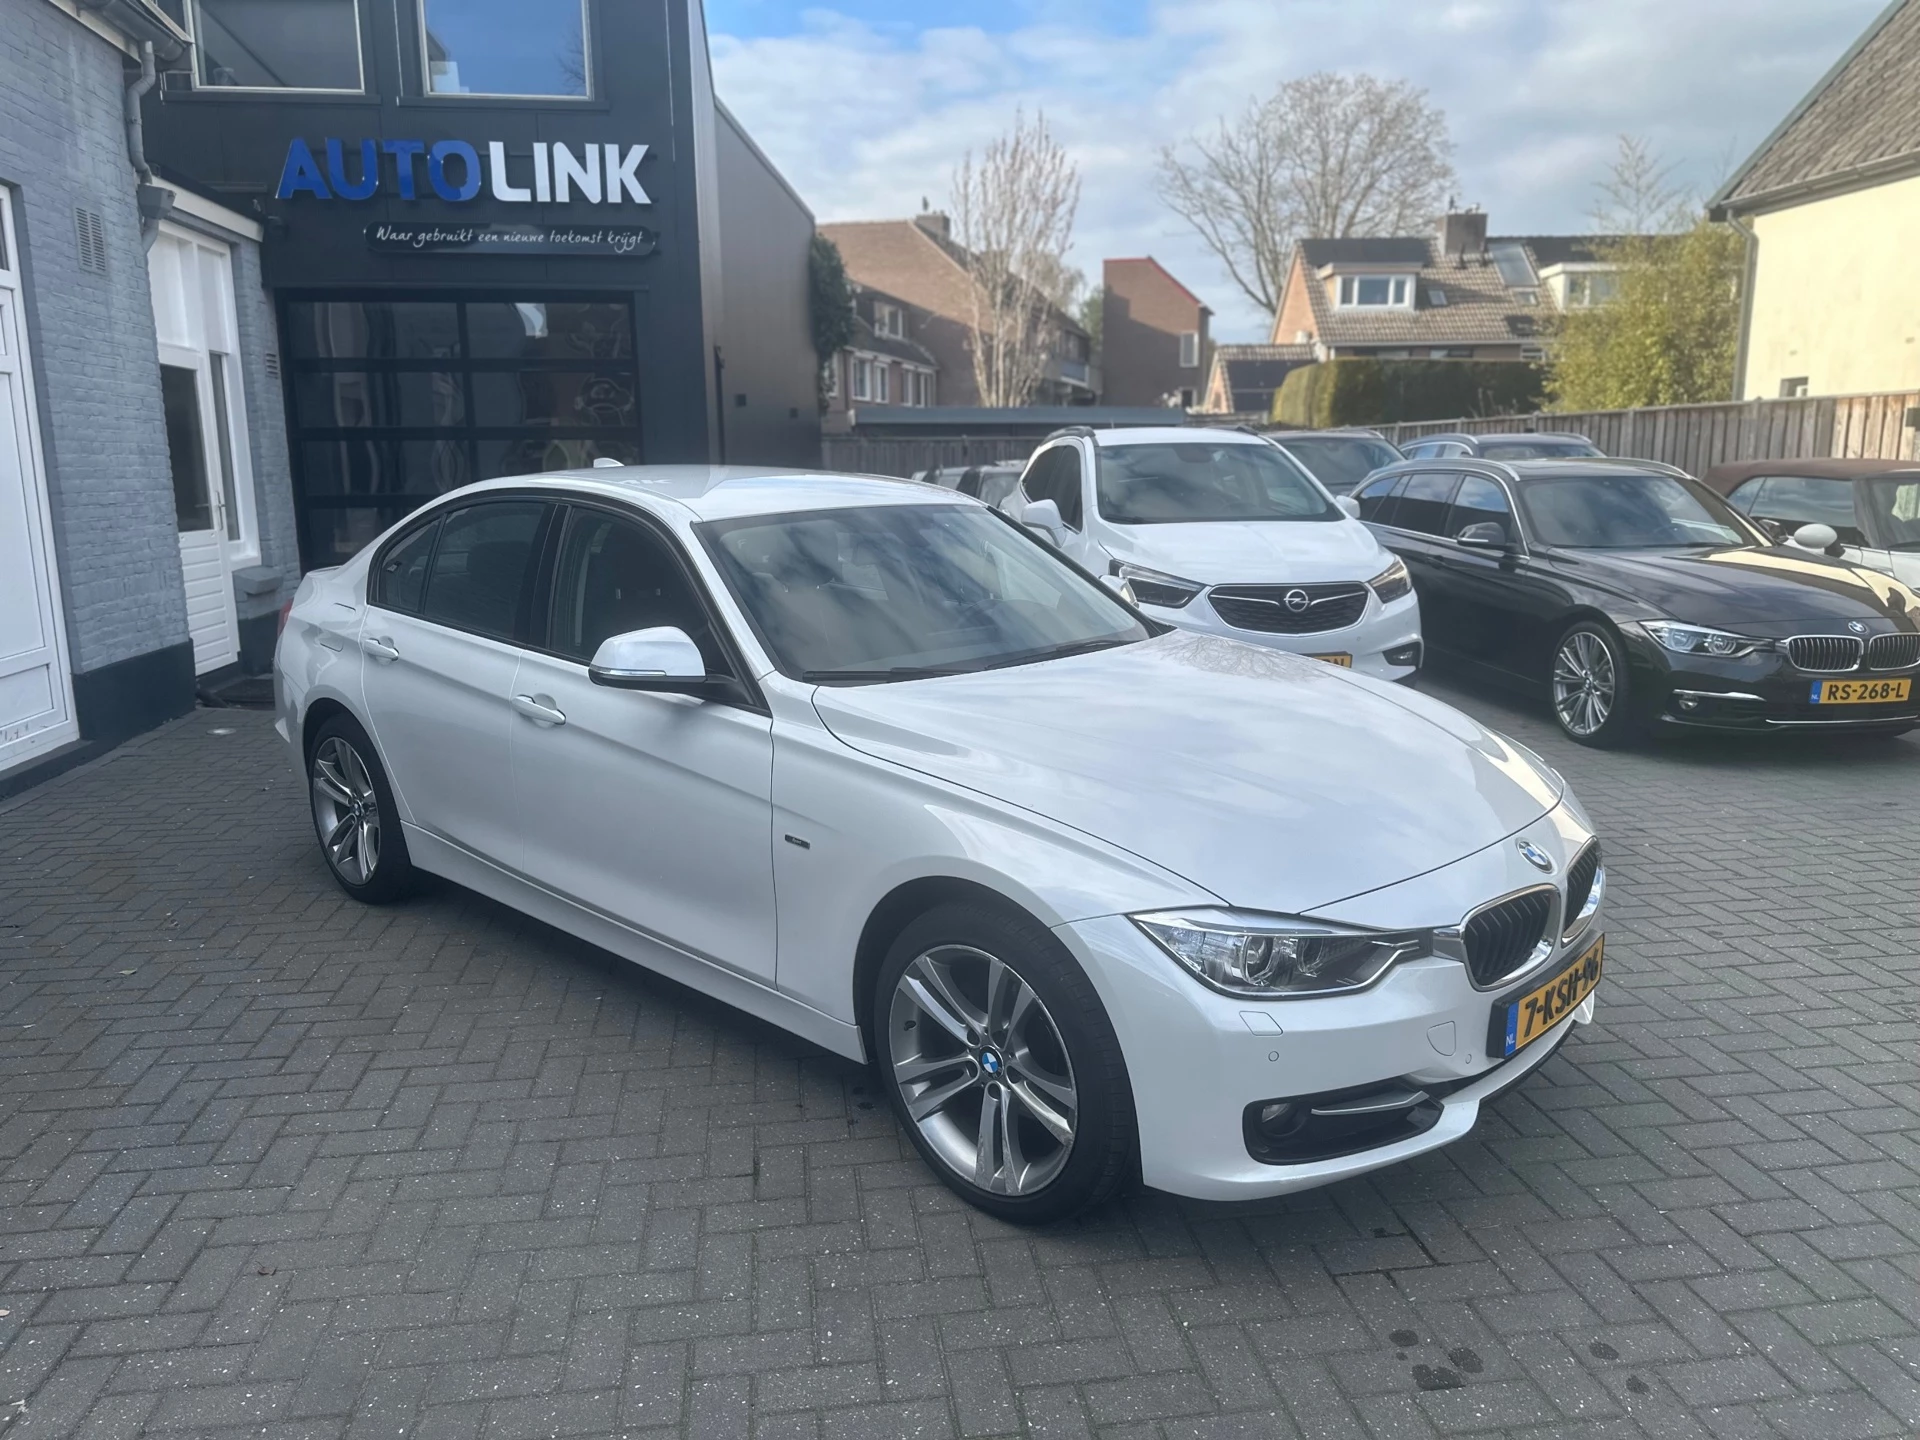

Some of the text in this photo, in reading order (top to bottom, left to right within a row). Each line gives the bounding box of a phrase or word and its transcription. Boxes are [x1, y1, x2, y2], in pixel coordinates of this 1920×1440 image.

[376, 225, 643, 254] Waar gebruikt een nieuwe toekomst krijgt
[1827, 682, 1904, 701] RS-268-L
[1523, 947, 1599, 1038] 7-KSH-96
[1506, 1033, 1516, 1047] NL
